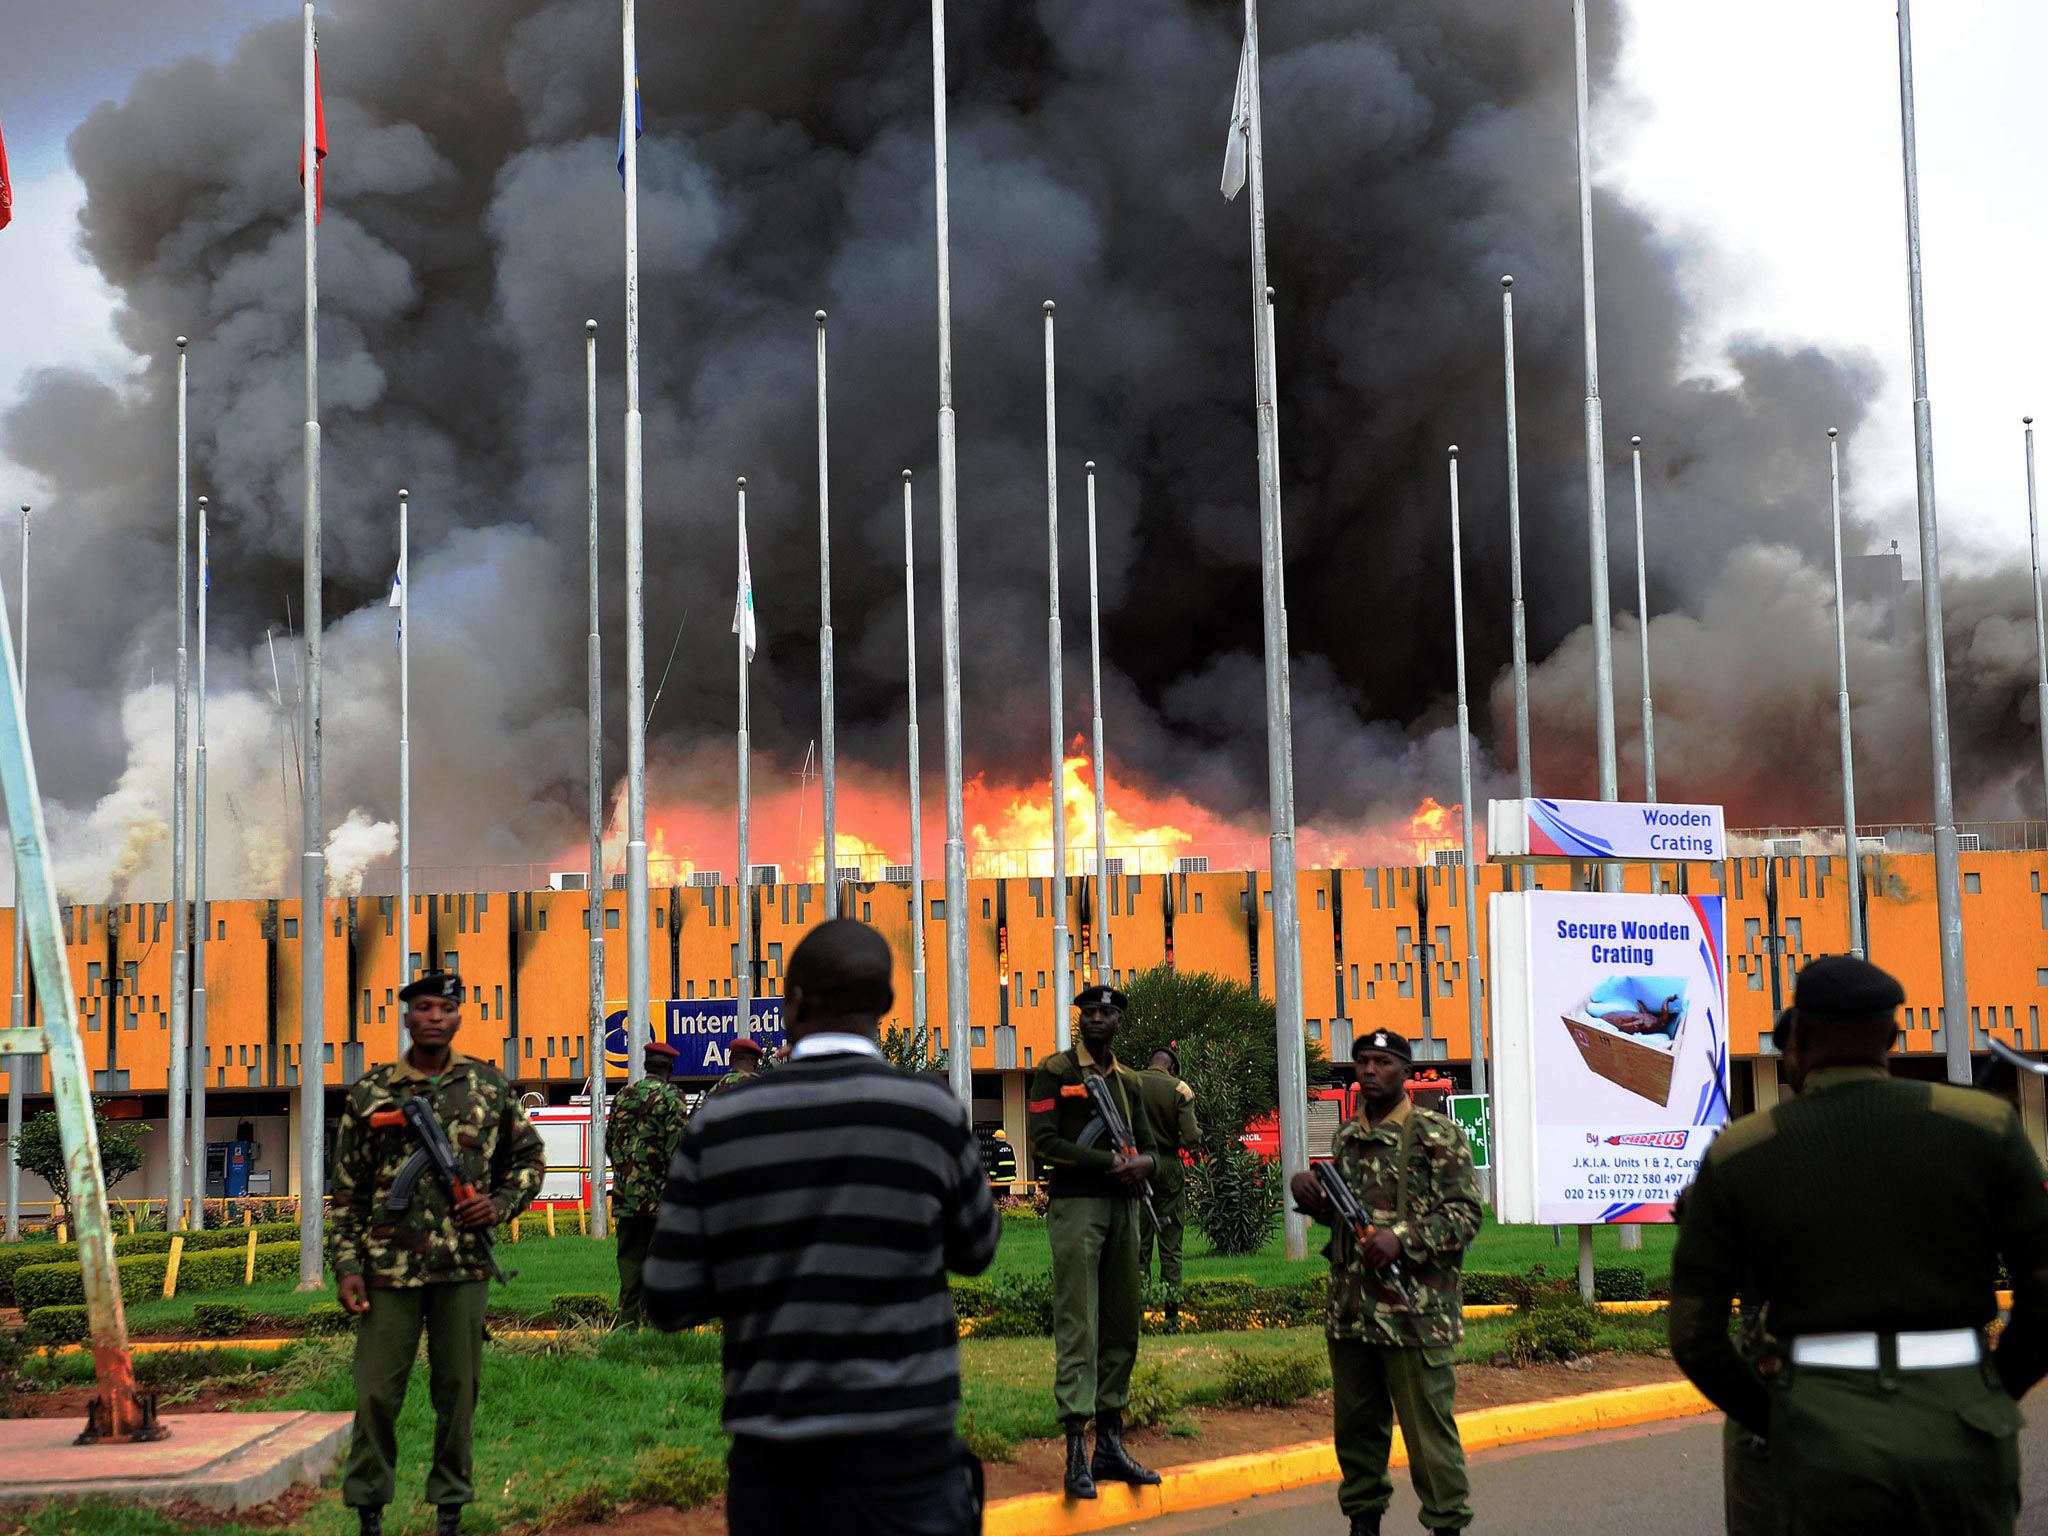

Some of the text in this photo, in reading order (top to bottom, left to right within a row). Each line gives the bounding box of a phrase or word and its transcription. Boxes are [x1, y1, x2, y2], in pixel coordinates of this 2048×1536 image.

[1642, 809, 1711, 826] Wooden
[1650, 834, 1713, 855] Crating
[1557, 919, 1690, 941] Secure Wooden
[1591, 944, 1654, 966] Crating
[1586, 1132, 1599, 1147] By
[1572, 1157, 1700, 1171] J.K.I.A. Units 1 & 2, Carg
[1587, 1173, 1610, 1184] Call:
[1613, 1173, 1639, 1184] 0722
[1642, 1173, 1662, 1184] 580
[1664, 1173, 1683, 1184] 497
[1564, 1188, 1584, 1199] 020
[1587, 1188, 1606, 1199] 215
[1609, 1188, 1634, 1199] 9179
[1637, 1188, 1642, 1199] /
[1644, 1188, 1669, 1199] 0721
